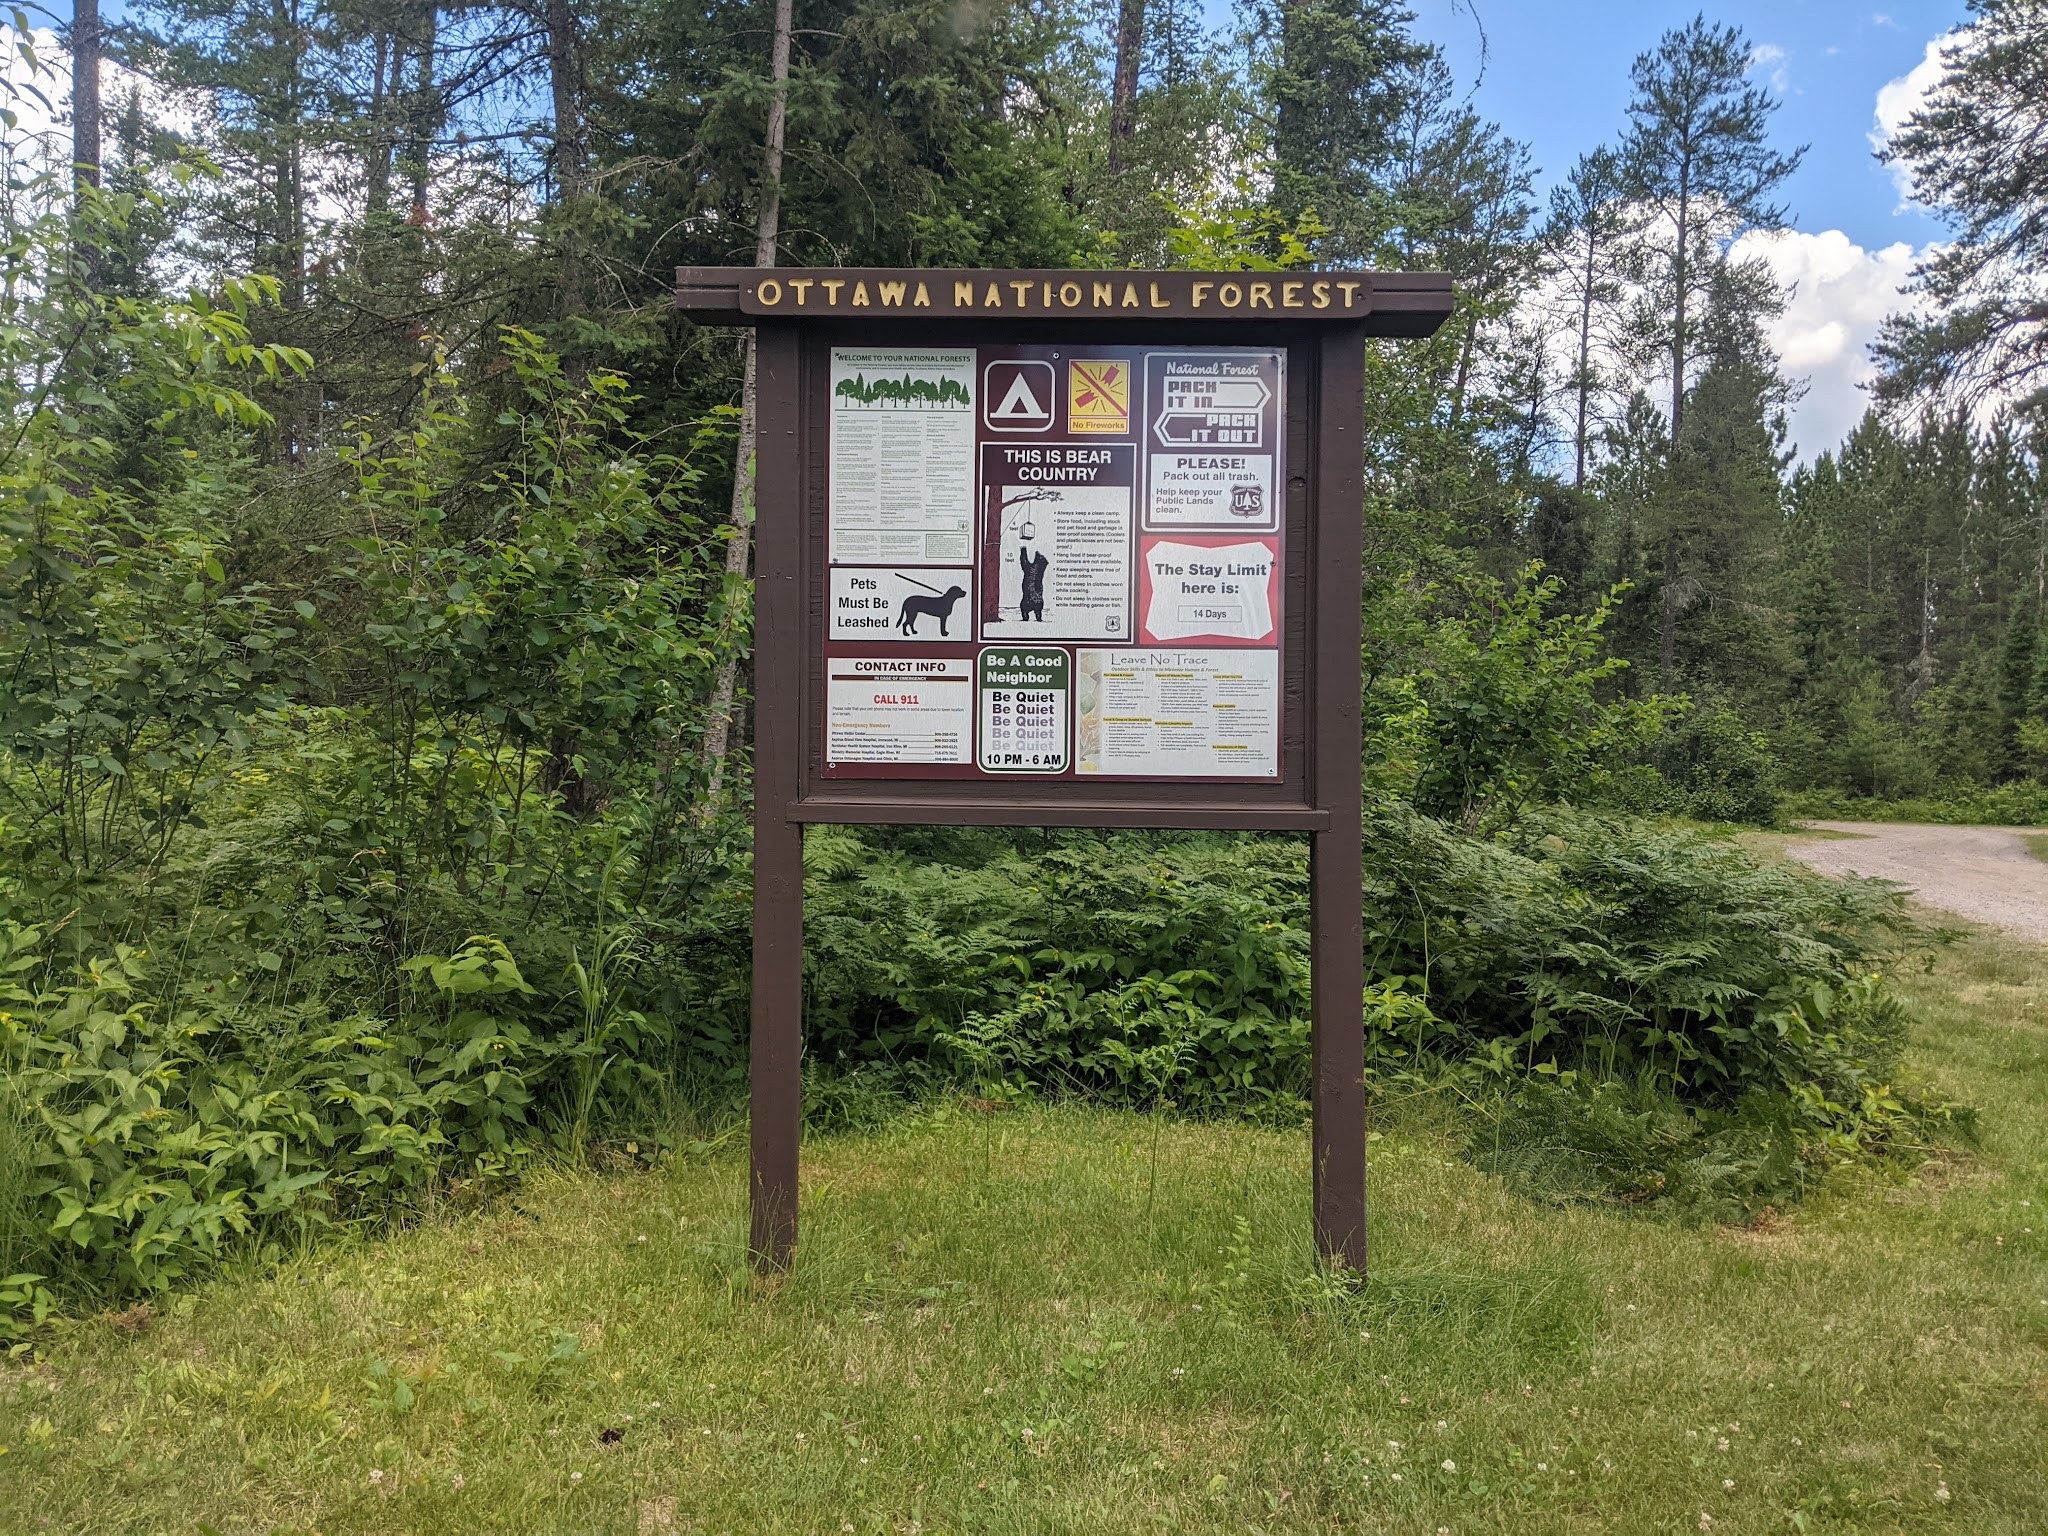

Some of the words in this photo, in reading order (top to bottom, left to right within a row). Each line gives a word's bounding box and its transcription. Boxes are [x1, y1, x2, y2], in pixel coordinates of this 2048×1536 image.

[757, 278, 930, 307] OTTAWA
[955, 280, 1171, 308] NATIONAL
[1192, 281, 1361, 309] FOREST
[1166, 362, 1219, 375] National
[1222, 362, 1260, 375] Forest
[1168, 381, 1217, 393] PACK
[1168, 396, 1187, 408] IT
[1206, 414, 1256, 426] PACK
[1192, 429, 1211, 442] IT
[1218, 429, 1256, 442] OUT
[1004, 449, 1041, 464] THIS
[1046, 450, 1061, 464] IS
[1066, 450, 1112, 464] BEAR
[1177, 458, 1246, 469] PLEASE!
[1018, 467, 1098, 481] COUNTRY
[1163, 472, 1189, 480] Pack
[1192, 472, 1210, 480] out
[1213, 472, 1225, 480] all
[1228, 472, 1259, 481] trash.
[1156, 488, 1176, 496] Help
[1178, 488, 1200, 497] keep
[1155, 563, 1184, 575] The
[1188, 563, 1222, 578] Stay
[1228, 564, 1267, 576] Limit
[850, 578, 877, 590] Pets
[1182, 582, 1216, 594] here
[1221, 582, 1239, 594] is:
[839, 597, 869, 608] Must
[873, 597, 889, 609] Be
[1193, 610, 1203, 618] 14
[1205, 610, 1226, 619] Days
[837, 616, 889, 628] Leashed
[986, 655, 1006, 667] Be
[1010, 655, 1020, 667] A
[1024, 655, 1062, 667] Good
[1111, 653, 1146, 665] Leave
[1150, 653, 1170, 665] No
[1173, 653, 1208, 665] Trace
[855, 662, 913, 672] CONTACT
[916, 662, 946, 672] INFO
[986, 671, 1052, 686] Neighbor
[874, 695, 898, 704] CALL
[901, 695, 919, 704] 911
[992, 691, 1011, 702] Be
[1016, 691, 1055, 703] Quiet
[992, 704, 1011, 714] Be
[1016, 704, 1055, 716] Quiet
[992, 716, 1011, 726] Be
[1016, 716, 1055, 728] Quiet
[992, 728, 1011, 738] Be
[1016, 728, 1055, 739] Quiet
[992, 740, 1011, 751] Be
[1016, 740, 1055, 752] Quiet
[987, 754, 1001, 765] 10
[1004, 754, 1022, 765] PM
[1032, 754, 1039, 765] 6
[1043, 754, 1061, 765] AM
